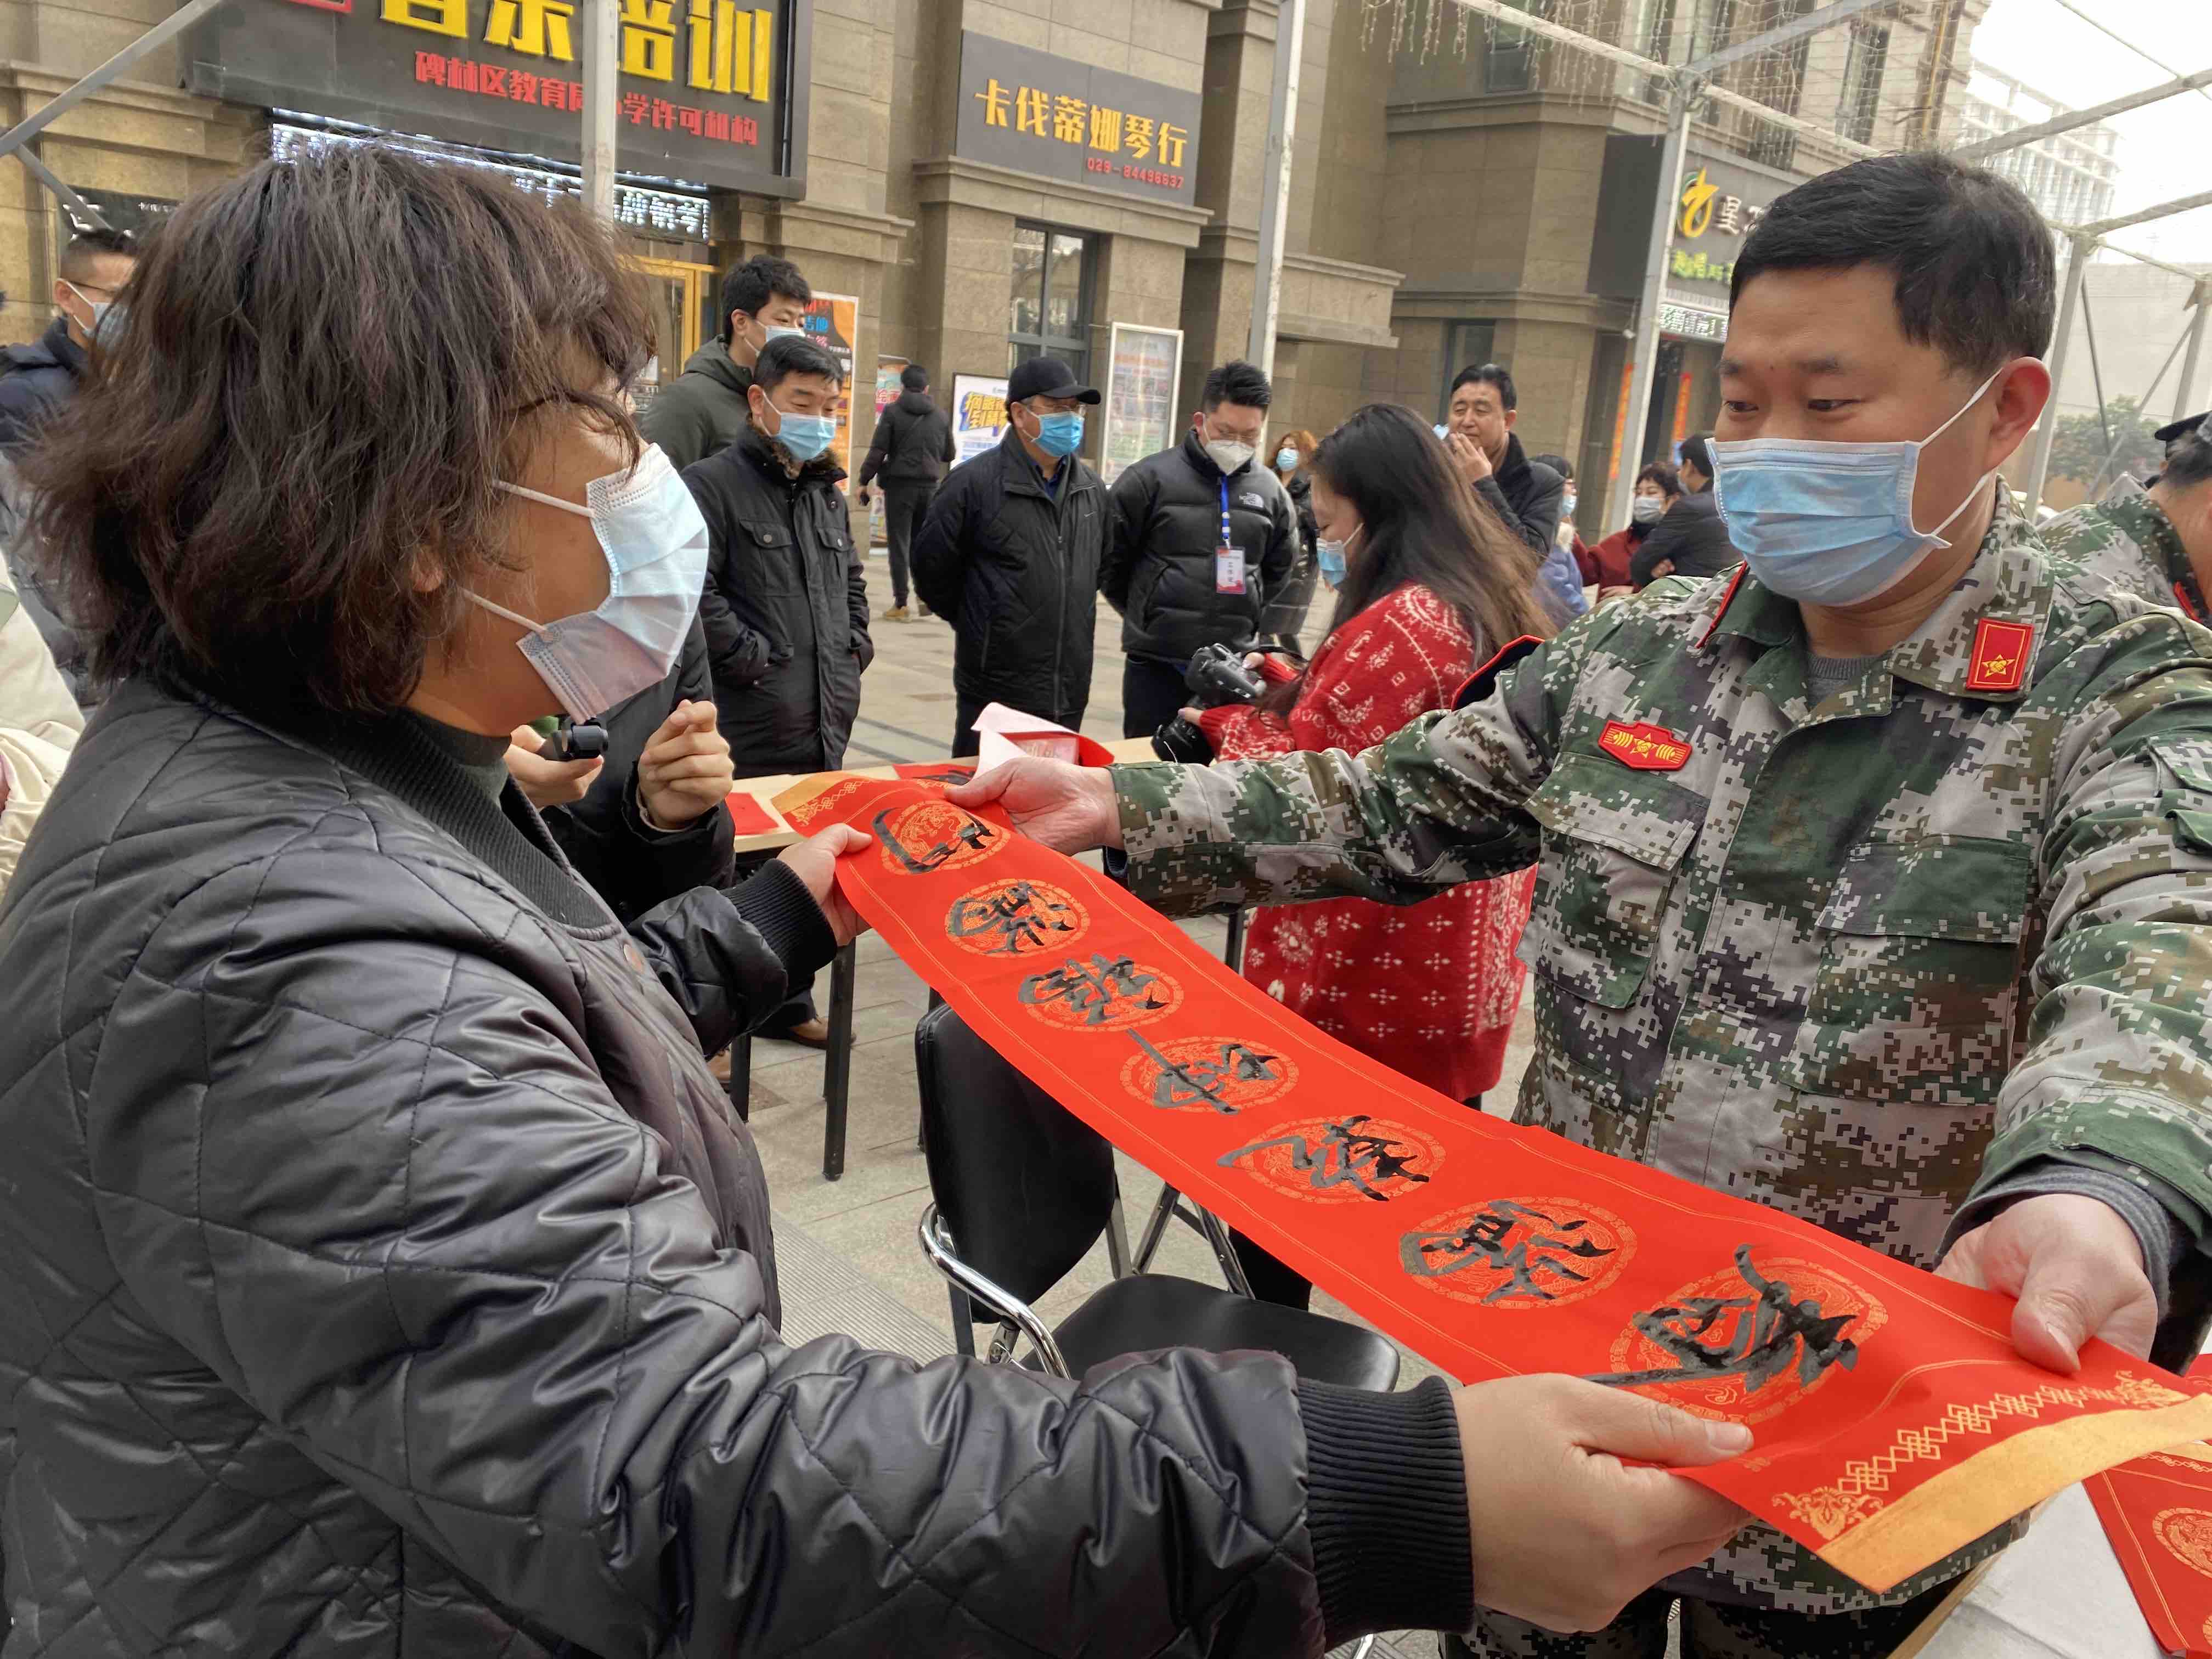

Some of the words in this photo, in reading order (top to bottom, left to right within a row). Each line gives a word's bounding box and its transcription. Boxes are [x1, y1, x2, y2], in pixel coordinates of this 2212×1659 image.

[415, 51, 758, 145] 碑林区教育局学许可机构
[975, 78, 1188, 168] 卡伐蒂娜琴行
